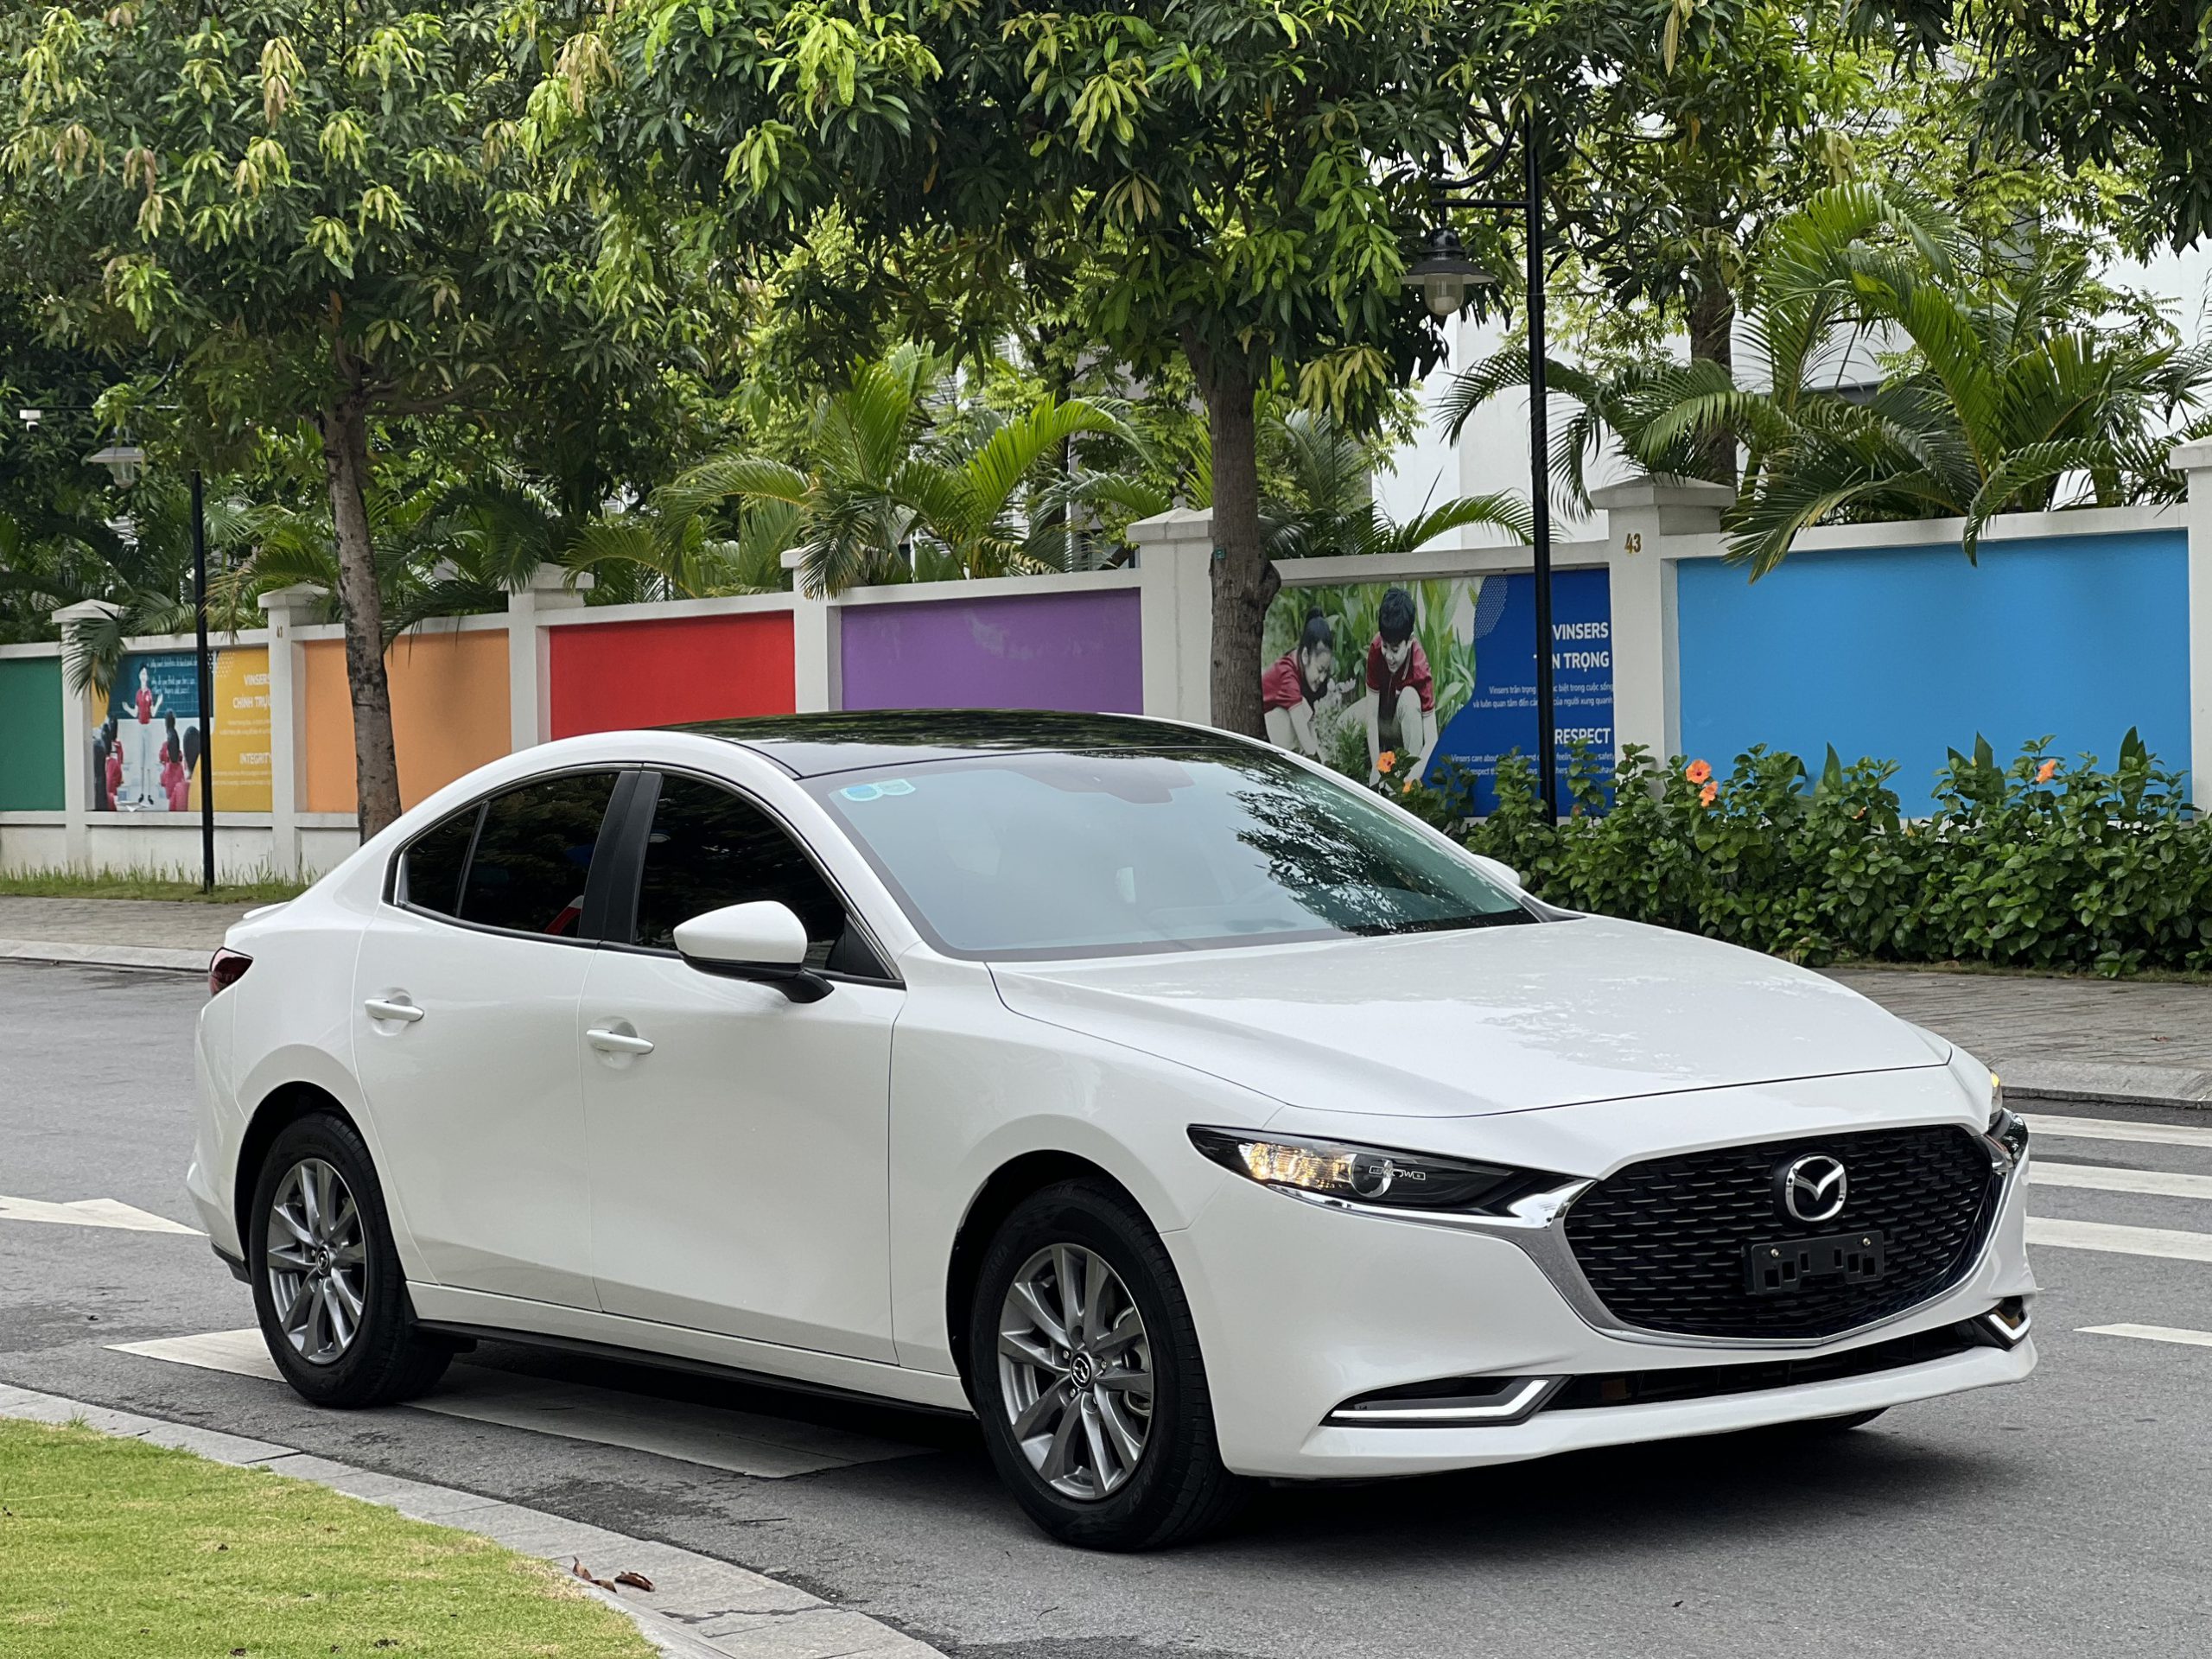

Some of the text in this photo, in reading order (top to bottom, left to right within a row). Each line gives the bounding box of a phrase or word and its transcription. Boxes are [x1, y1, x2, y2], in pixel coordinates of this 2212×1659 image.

[1624, 532, 1641, 554] 43
[1553, 622, 1609, 640] VINSERS
[1563, 651, 1610, 672] TRỌNG
[1554, 728, 1611, 745] RESPECT
